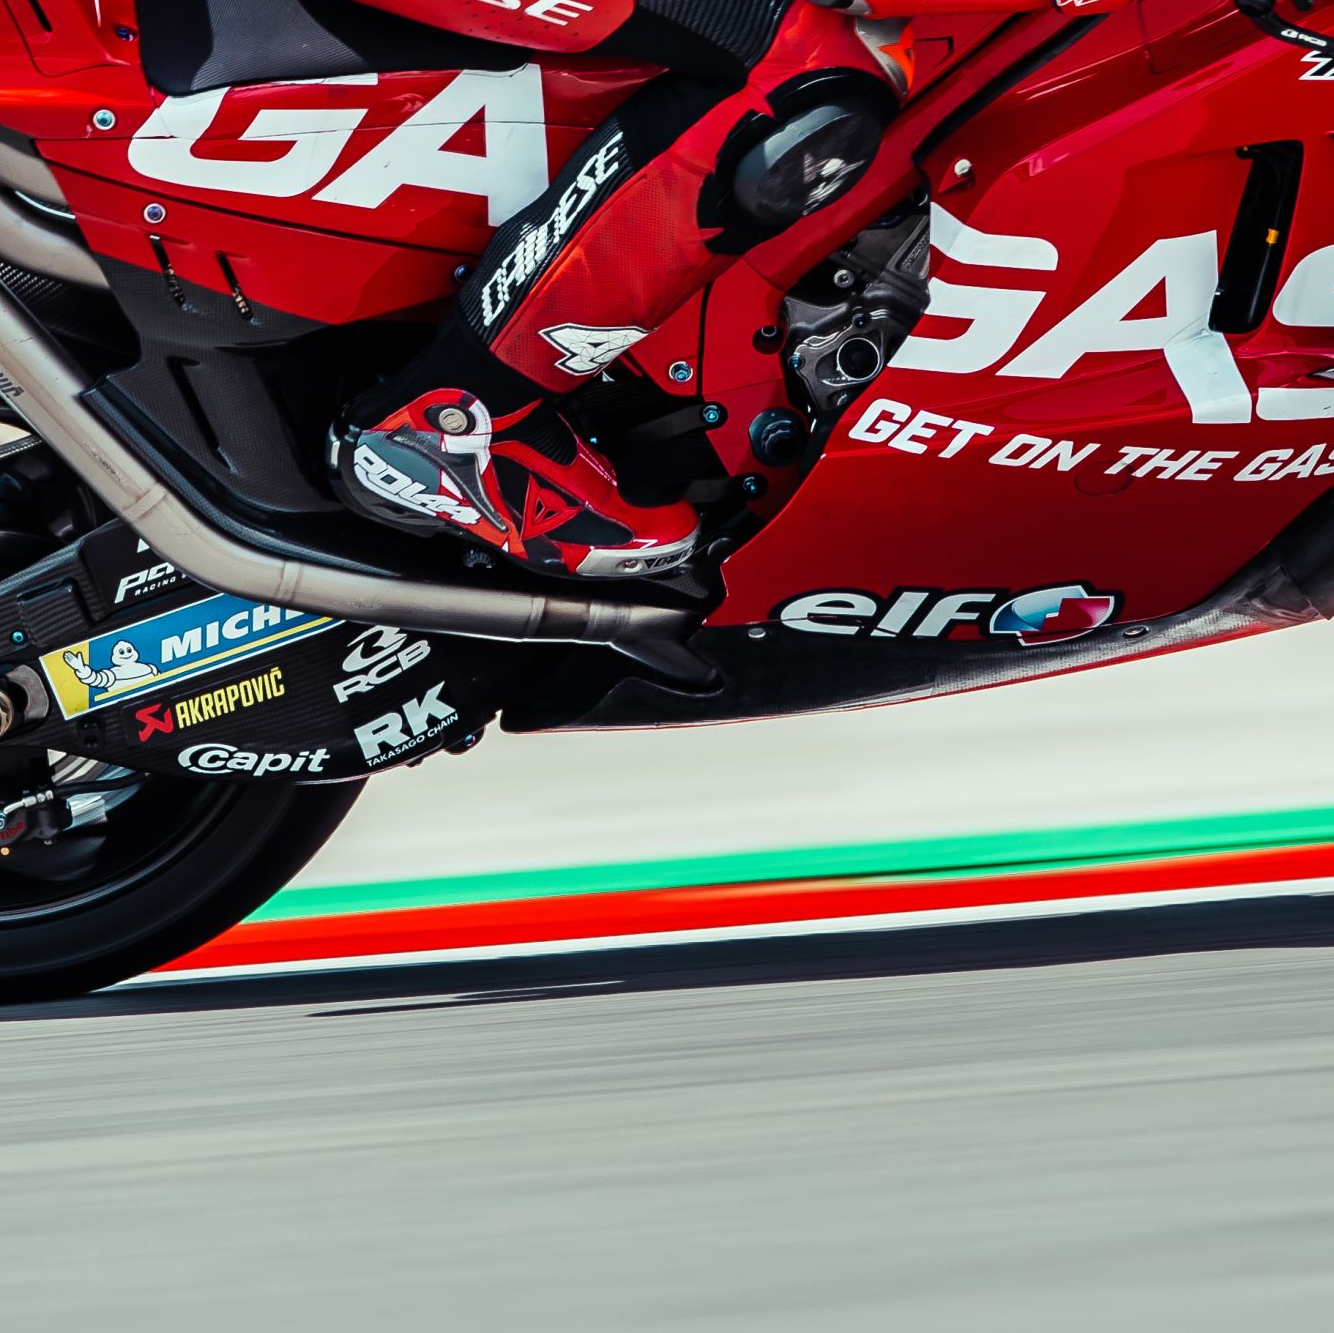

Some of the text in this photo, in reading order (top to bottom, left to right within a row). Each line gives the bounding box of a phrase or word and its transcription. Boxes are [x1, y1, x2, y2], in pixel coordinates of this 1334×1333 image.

[847, 397, 995, 460] GET
[988, 432, 1107, 473] ON
[1105, 443, 1240, 483] THE
[133, 574, 177, 597] RACING
[778, 591, 998, 638] elf
[174, 666, 286, 730] AKRAPOVIČ
[332, 639, 432, 704] RCB
[353, 680, 457, 760] RK
[366, 712, 460, 768] TAKASAGO CHAIN
